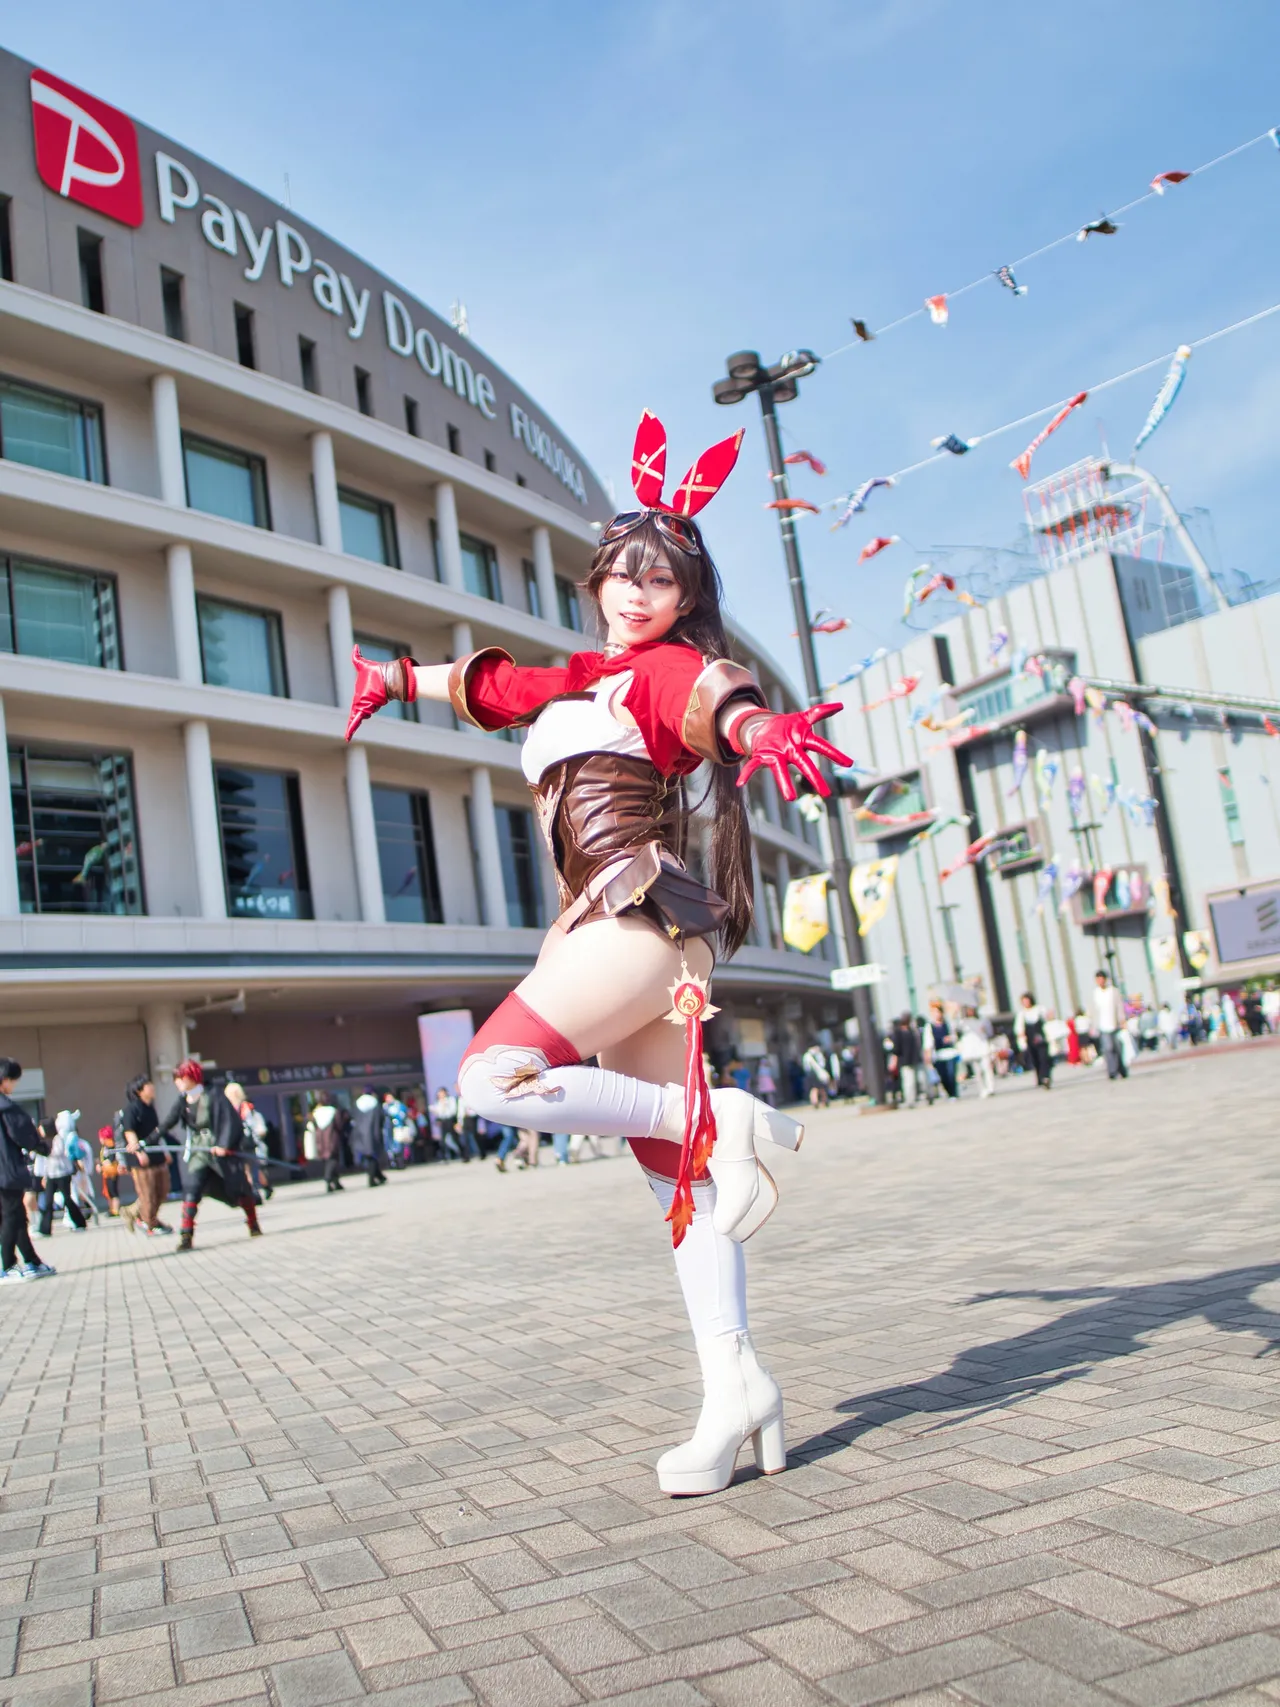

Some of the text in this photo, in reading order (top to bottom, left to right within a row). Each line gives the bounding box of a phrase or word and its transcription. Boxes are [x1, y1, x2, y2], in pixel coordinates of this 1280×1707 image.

[155, 150, 588, 506] PayPay Dome FUKUOKA
